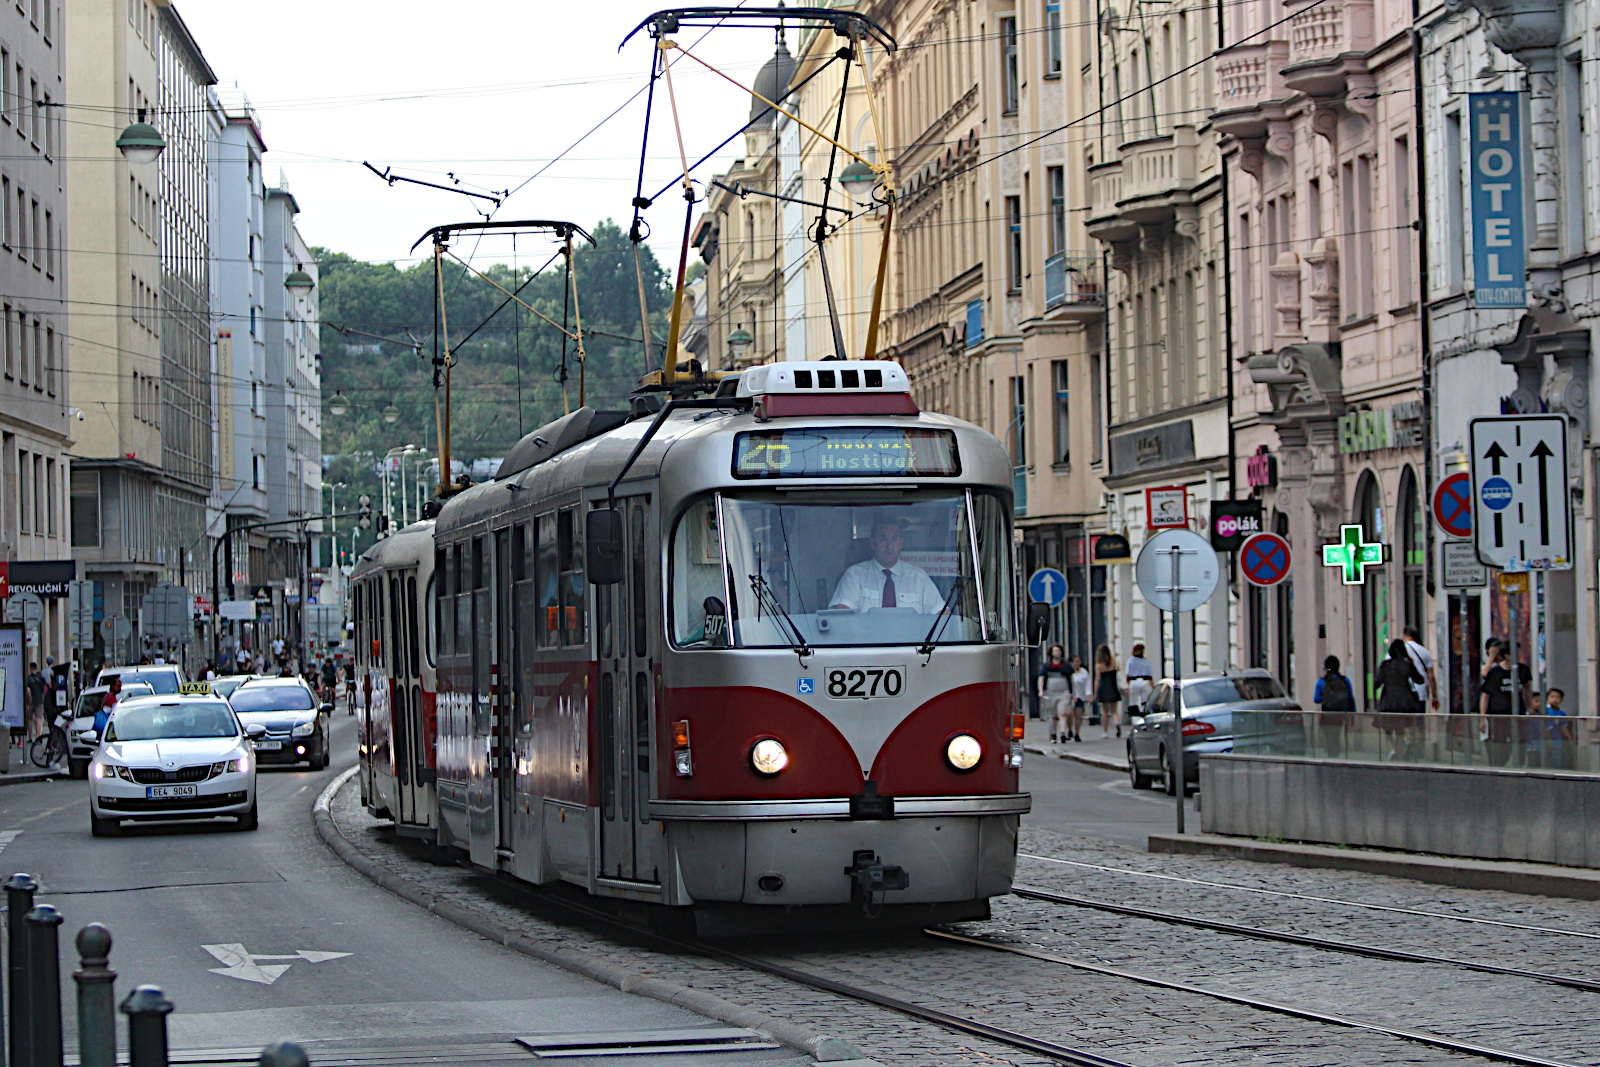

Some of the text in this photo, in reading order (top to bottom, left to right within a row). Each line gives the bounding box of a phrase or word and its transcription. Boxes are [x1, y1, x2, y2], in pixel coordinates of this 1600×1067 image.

[1478, 113, 1513, 282] HOTEL
[821, 452, 917, 469] Hostivař
[1153, 516, 1184, 524] OKOLO
[1218, 515, 1260, 536] polák
[8, 582, 70, 593] REVOLUČNÍ 7
[704, 614, 725, 635] 507
[184, 683, 208, 693] TAXI
[827, 669, 902, 697] 8270
[153, 786, 193, 796] 6E4 9049
